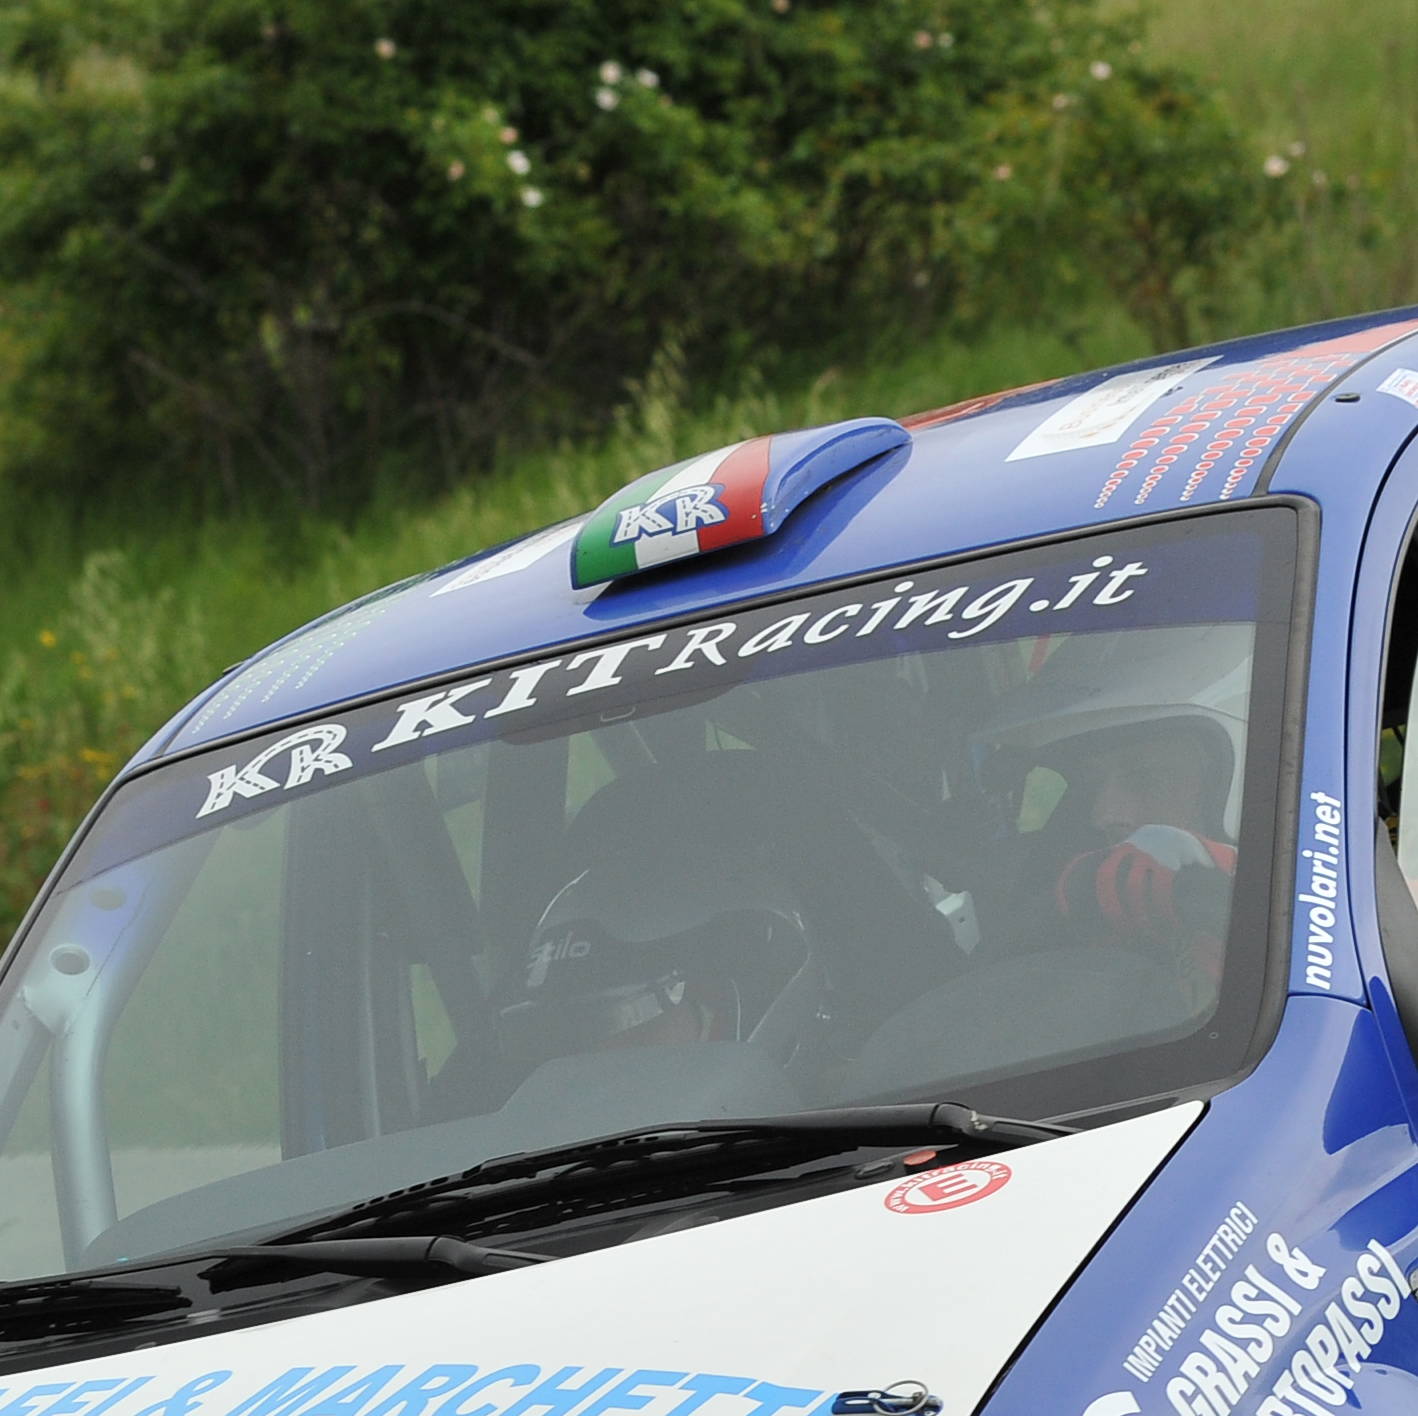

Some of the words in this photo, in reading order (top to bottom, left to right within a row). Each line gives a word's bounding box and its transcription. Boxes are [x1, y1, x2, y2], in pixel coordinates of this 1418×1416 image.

[614, 482, 726, 544] KR
[195, 724, 355, 820] KR
[1297, 791, 1342, 991] nuvolari.net
[1122, 1288, 1198, 1383] IMPIANTI
[1181, 1200, 1259, 1303] ELETTRICI
[1265, 1232, 1327, 1290] &
